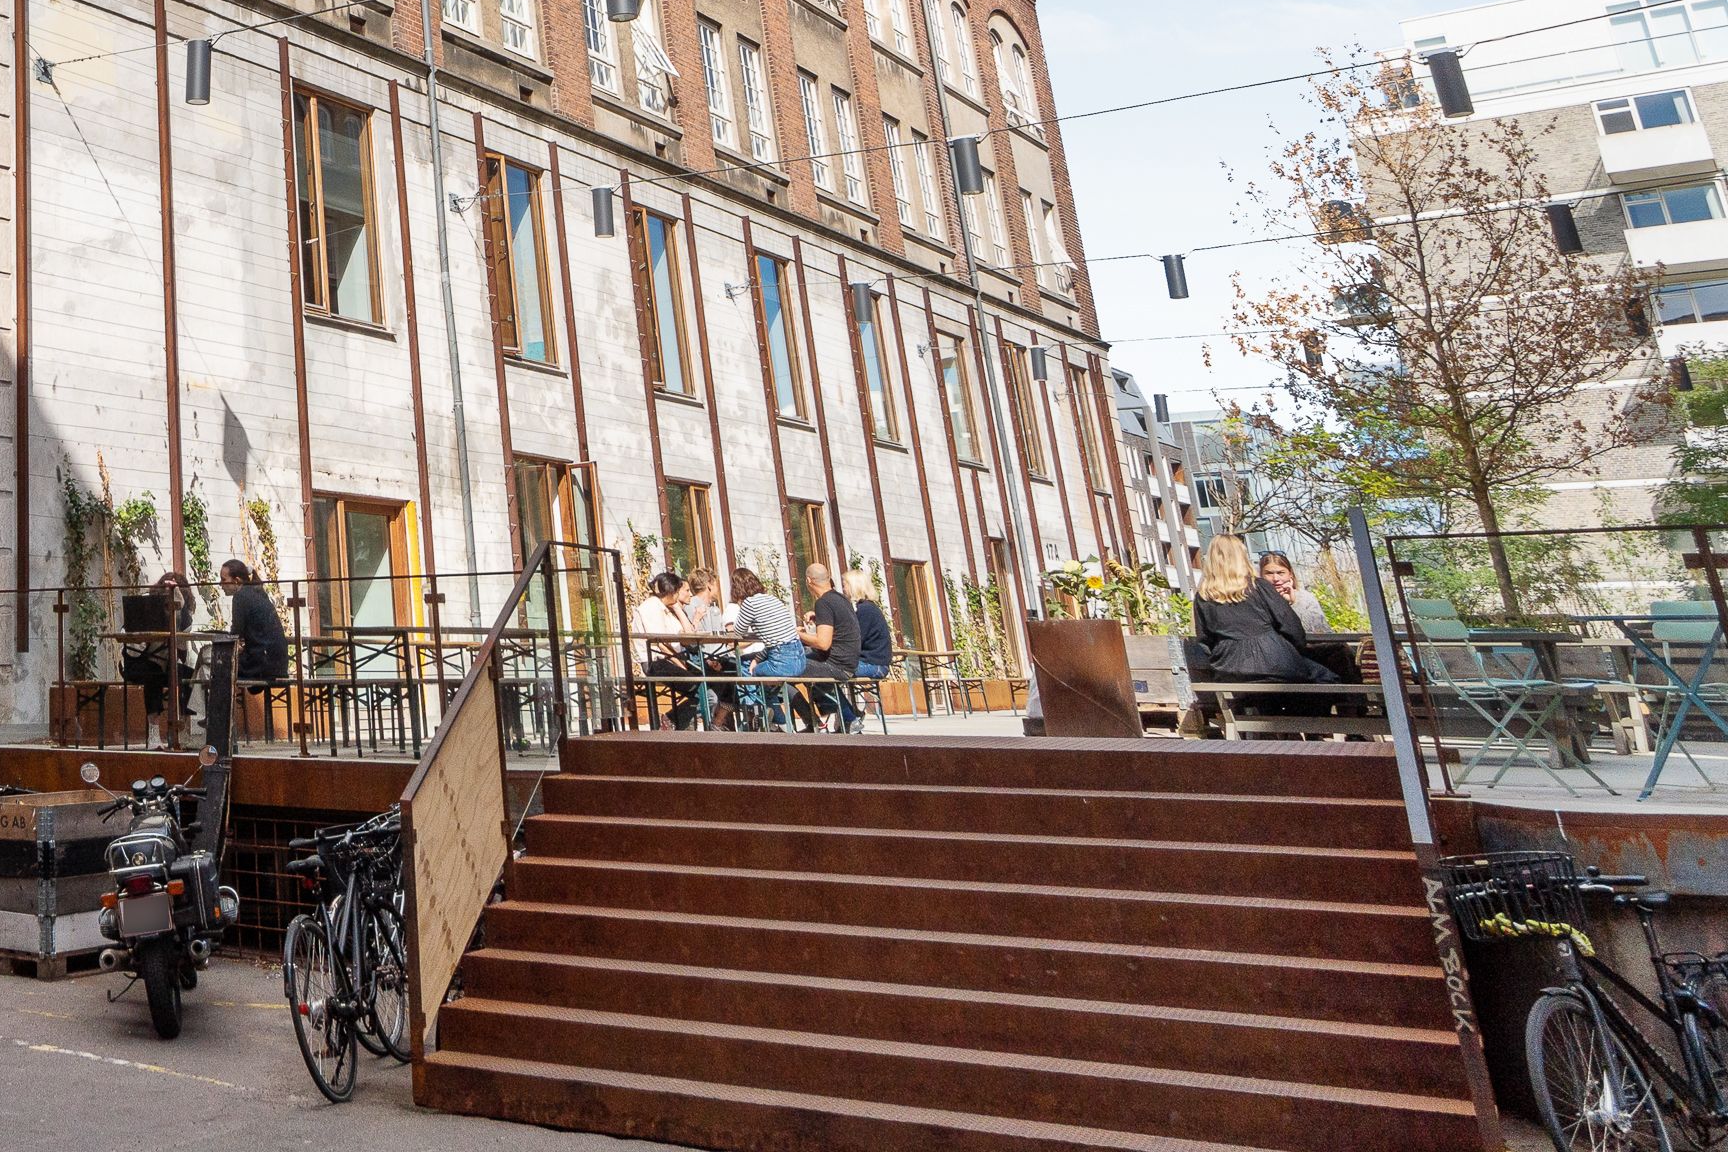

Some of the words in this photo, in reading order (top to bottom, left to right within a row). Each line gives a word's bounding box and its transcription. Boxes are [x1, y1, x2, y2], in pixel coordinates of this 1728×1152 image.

[1045, 542, 1060, 560] 17A
[12, 815, 26, 829] AB
[1422, 876, 1452, 944] ALM
[1440, 948, 1475, 1032] BOCK
